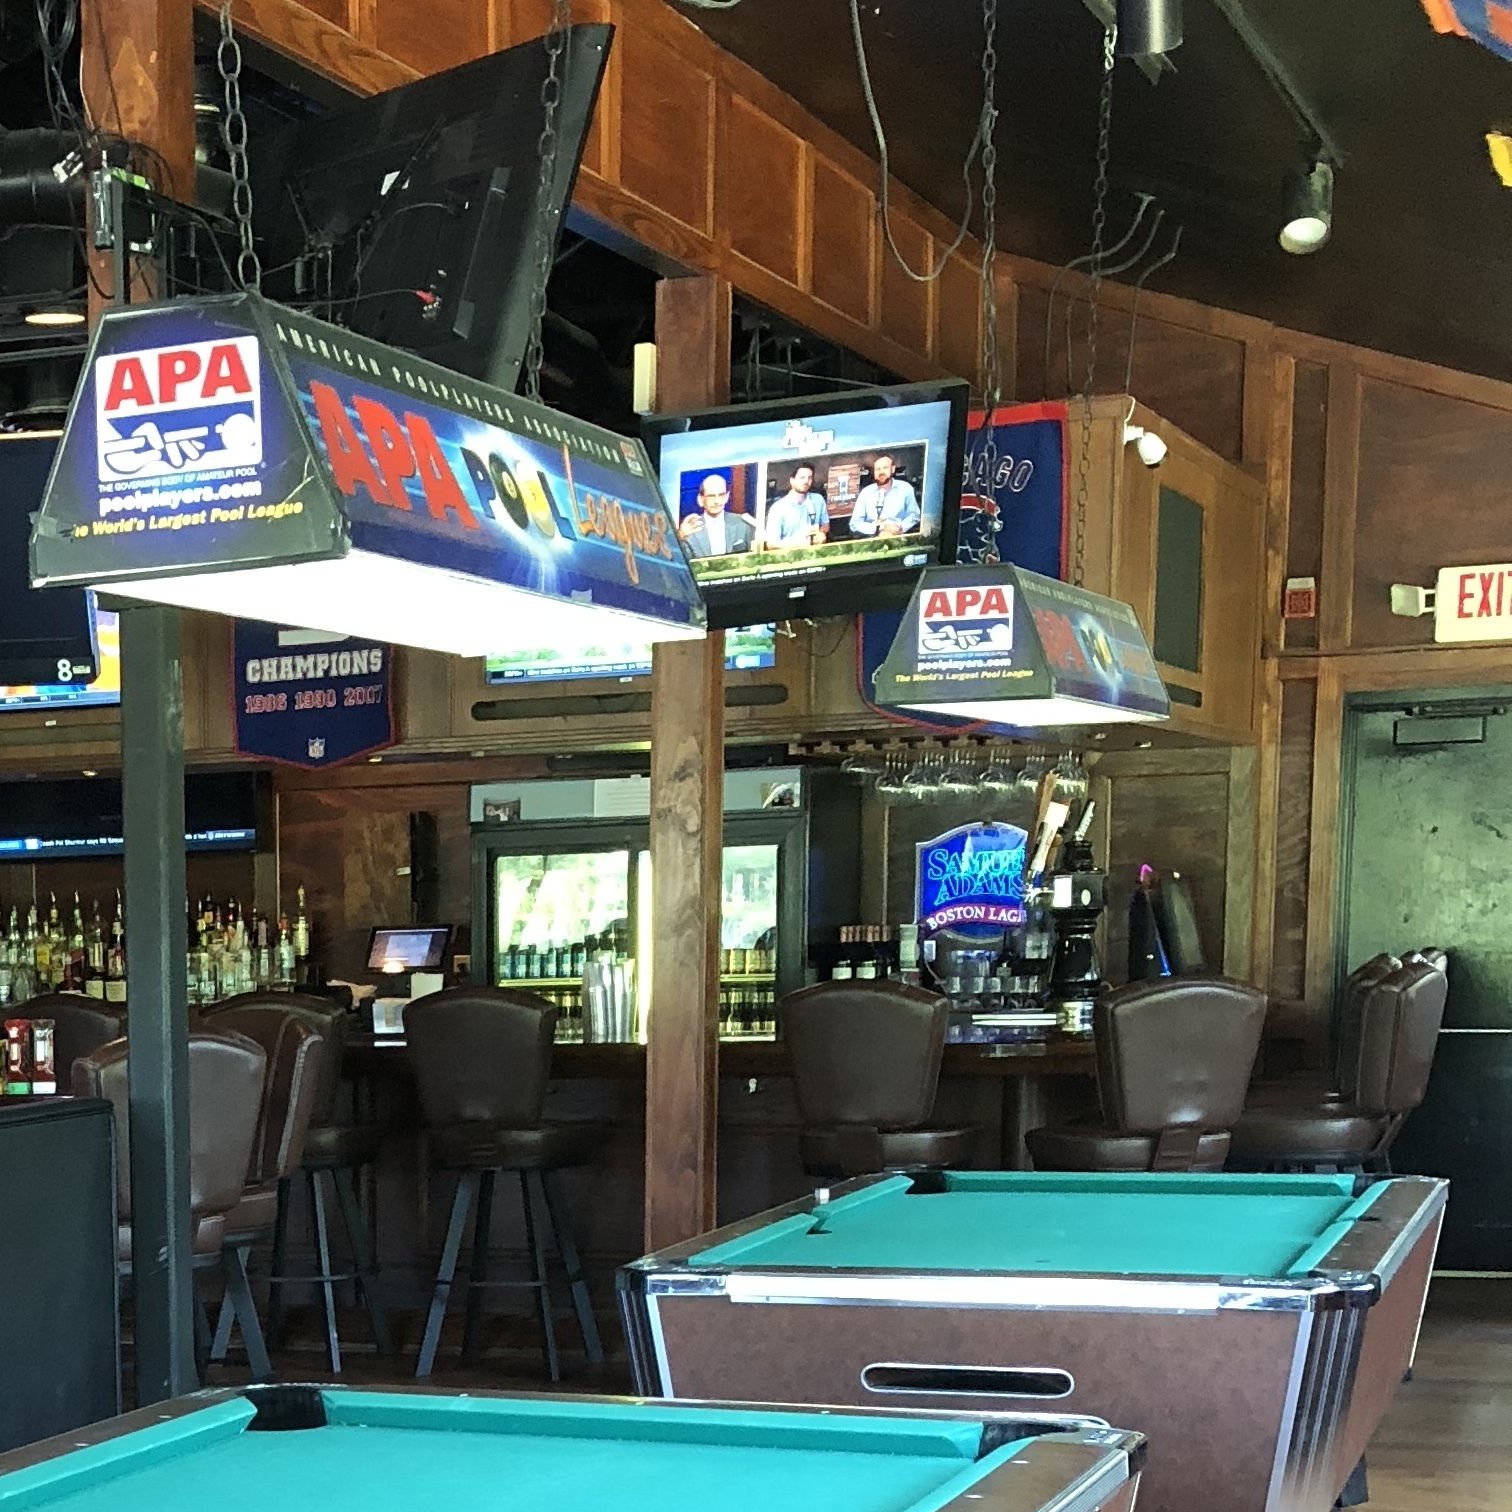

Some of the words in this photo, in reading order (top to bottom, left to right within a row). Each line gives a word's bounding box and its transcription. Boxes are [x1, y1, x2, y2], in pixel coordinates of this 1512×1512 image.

[104, 344, 253, 411] APA
[276, 322, 382, 376] AMERICAN
[392, 366, 515, 424] POOLPLAYERS
[523, 415, 621, 464] ASSOCIATION
[309, 380, 481, 530] APA
[99, 484, 114, 493] THE
[198, 470, 235, 481] AMATEUR
[236, 467, 258, 477] POOL
[100, 480, 262, 517] poolplayers.com
[93, 517, 146, 535] World's
[149, 510, 208, 531] Largest
[210, 506, 244, 522] Pool
[248, 501, 304, 519] League
[924, 588, 1009, 618] APA
[1457, 571, 1512, 619] EXI
[57, 659, 73, 682] 8
[245, 648, 383, 683] CHAMPIONS
[896, 674, 910, 682] The
[946, 672, 978, 680] Largest
[981, 670, 1001, 678] Pool
[1002, 669, 1033, 678] League
[917, 658, 1011, 672] poolplayers.com
[245, 693, 288, 714] 1986
[294, 688, 336, 710] 1990
[343, 684, 383, 706] 2007
[928, 846, 1025, 881] SAMUE
[926, 905, 986, 930] BOSTON
